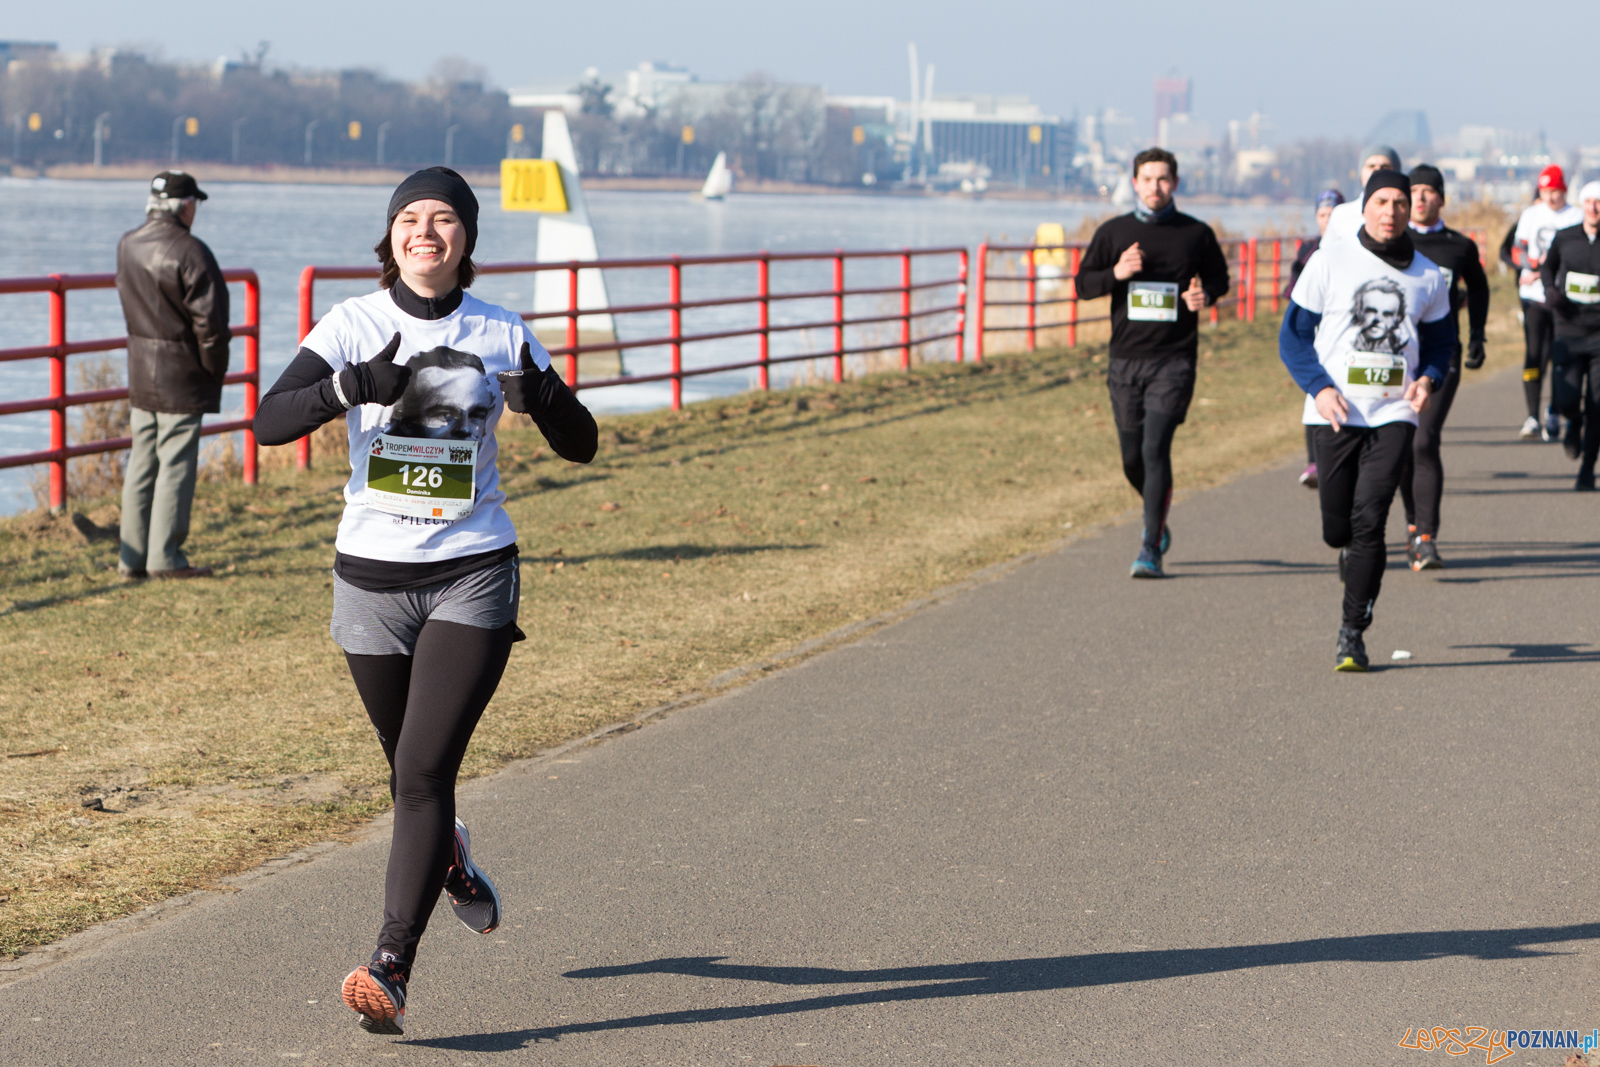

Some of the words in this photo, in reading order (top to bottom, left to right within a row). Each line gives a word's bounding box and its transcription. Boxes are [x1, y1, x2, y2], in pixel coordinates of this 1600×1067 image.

[511, 165, 547, 203] 200
[1141, 293, 1164, 307] 618
[1364, 367, 1390, 383] 175
[385, 442, 445, 455] TROPEMWILCZYM
[399, 464, 443, 488] 126
[406, 488, 431, 496] Dominika
